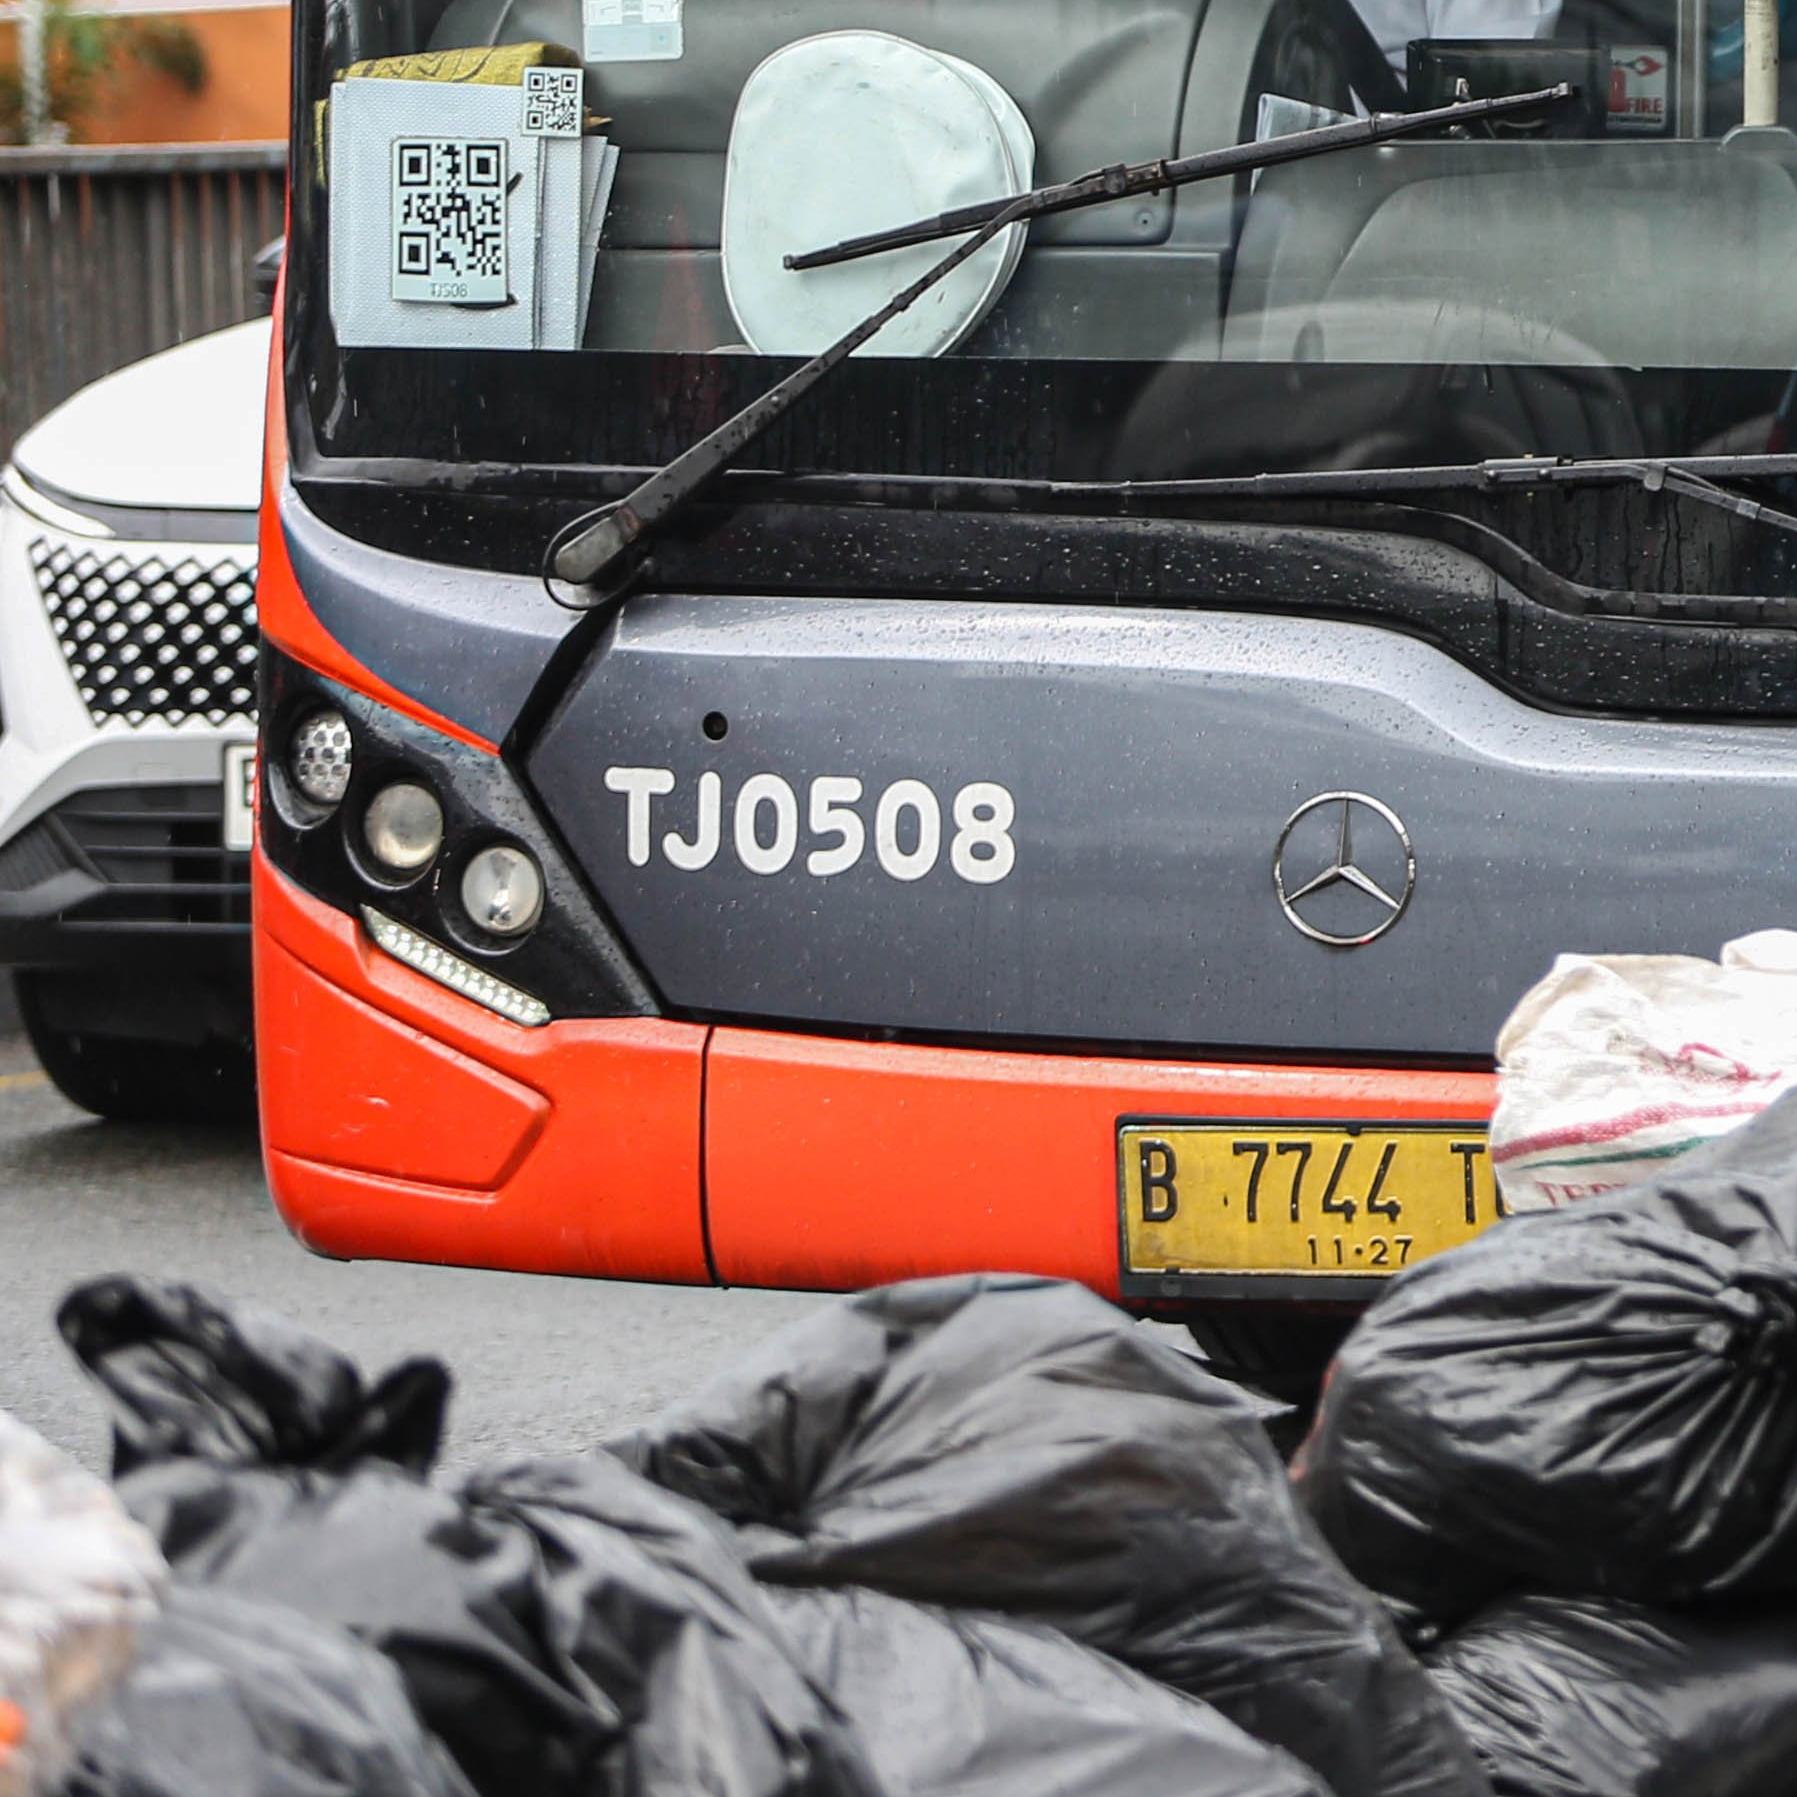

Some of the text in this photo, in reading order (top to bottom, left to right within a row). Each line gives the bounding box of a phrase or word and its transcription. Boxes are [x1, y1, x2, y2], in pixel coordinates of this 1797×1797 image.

[604, 766, 1016, 885] TJ0508
[1139, 1139, 1507, 1224] B 7744 T
